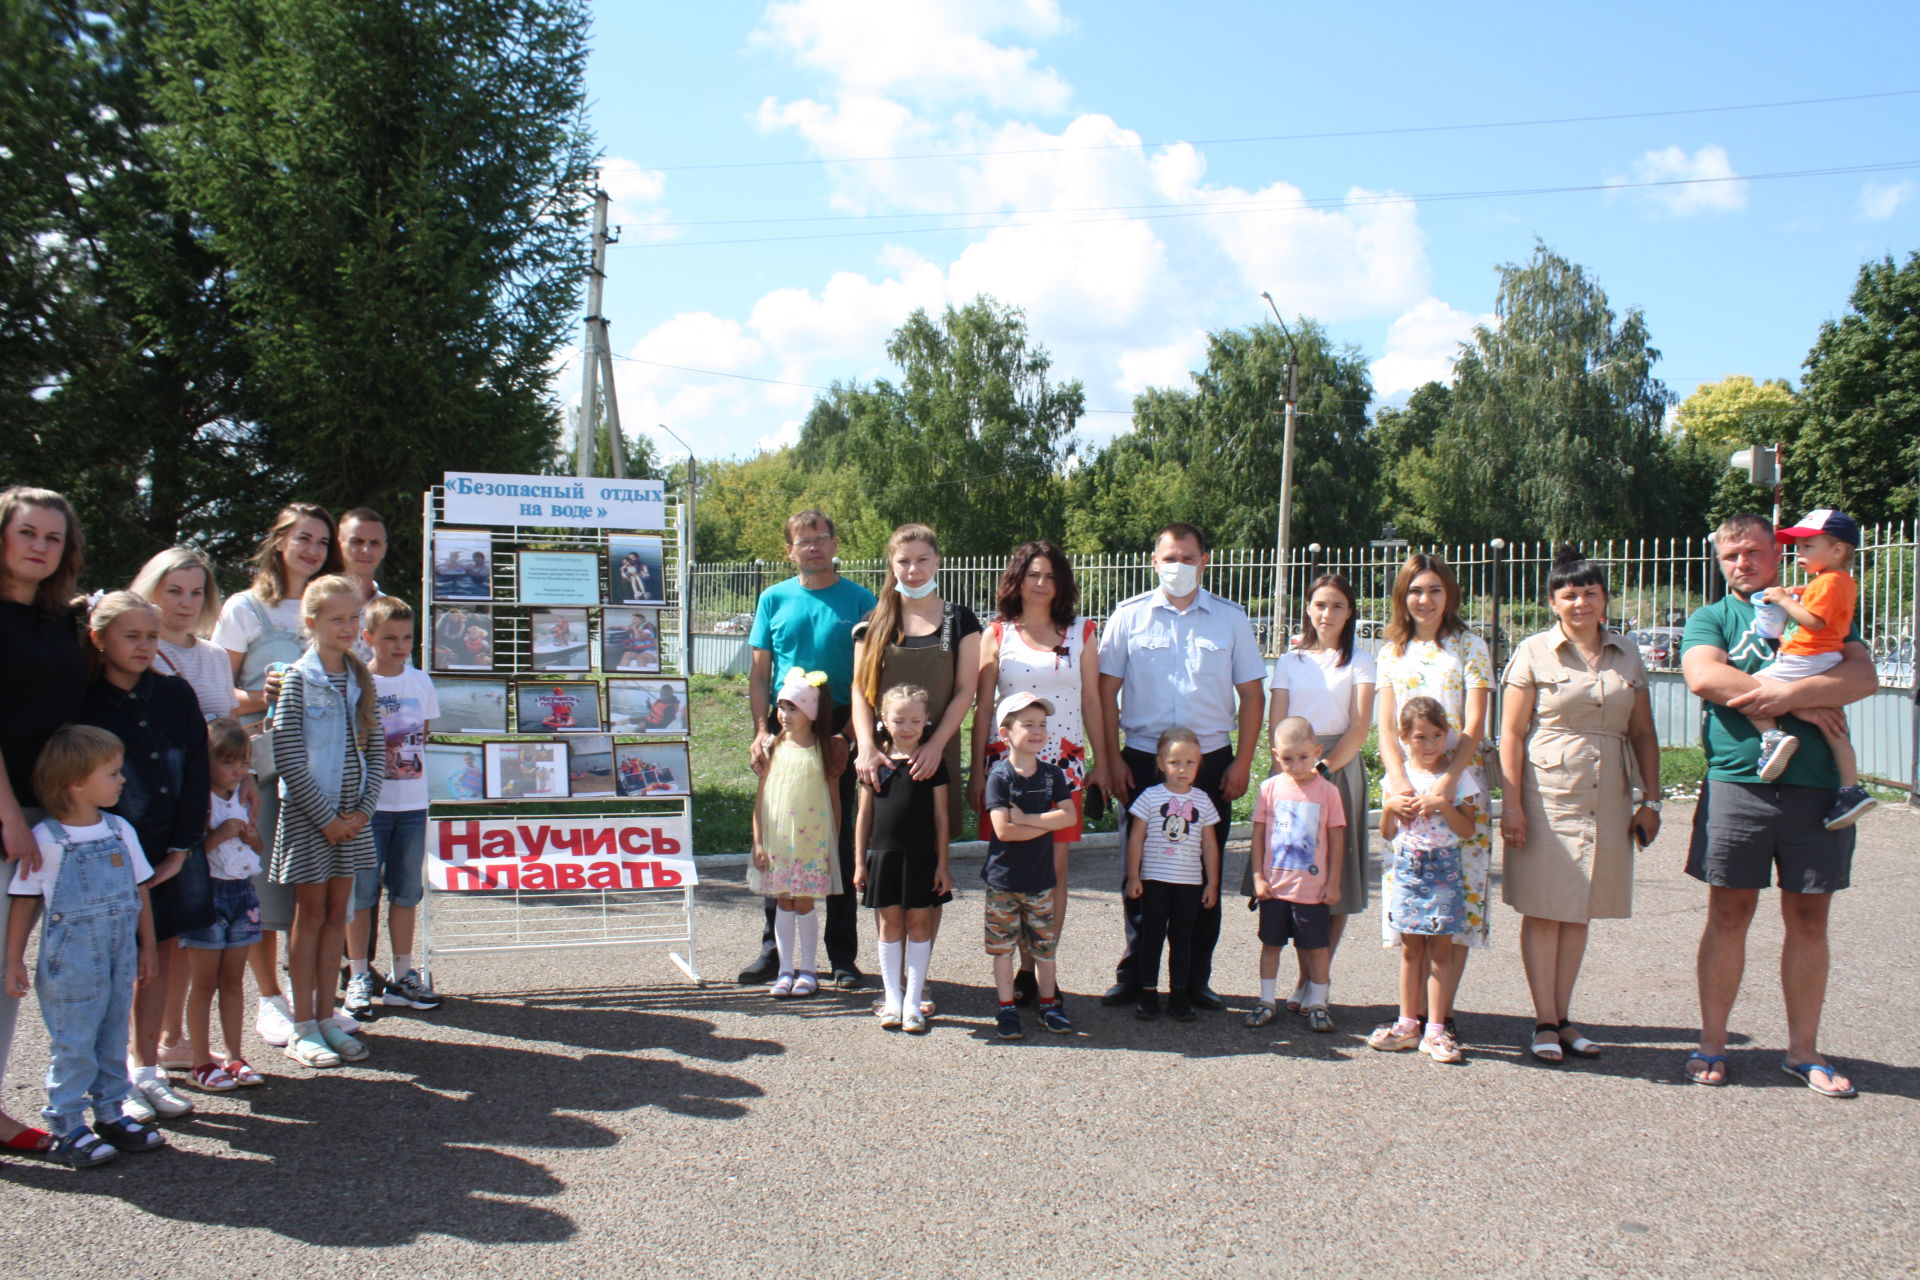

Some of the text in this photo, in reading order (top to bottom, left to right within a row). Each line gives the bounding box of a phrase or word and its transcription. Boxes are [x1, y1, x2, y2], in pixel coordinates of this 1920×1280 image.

[444, 477, 663, 503] «Безопасный отдых
[519, 503, 542, 516] на
[384, 703, 401, 714] TRIP
[1275, 820, 1289, 828] THE
[438, 821, 681, 862] Научись
[445, 860, 683, 890] плавать
